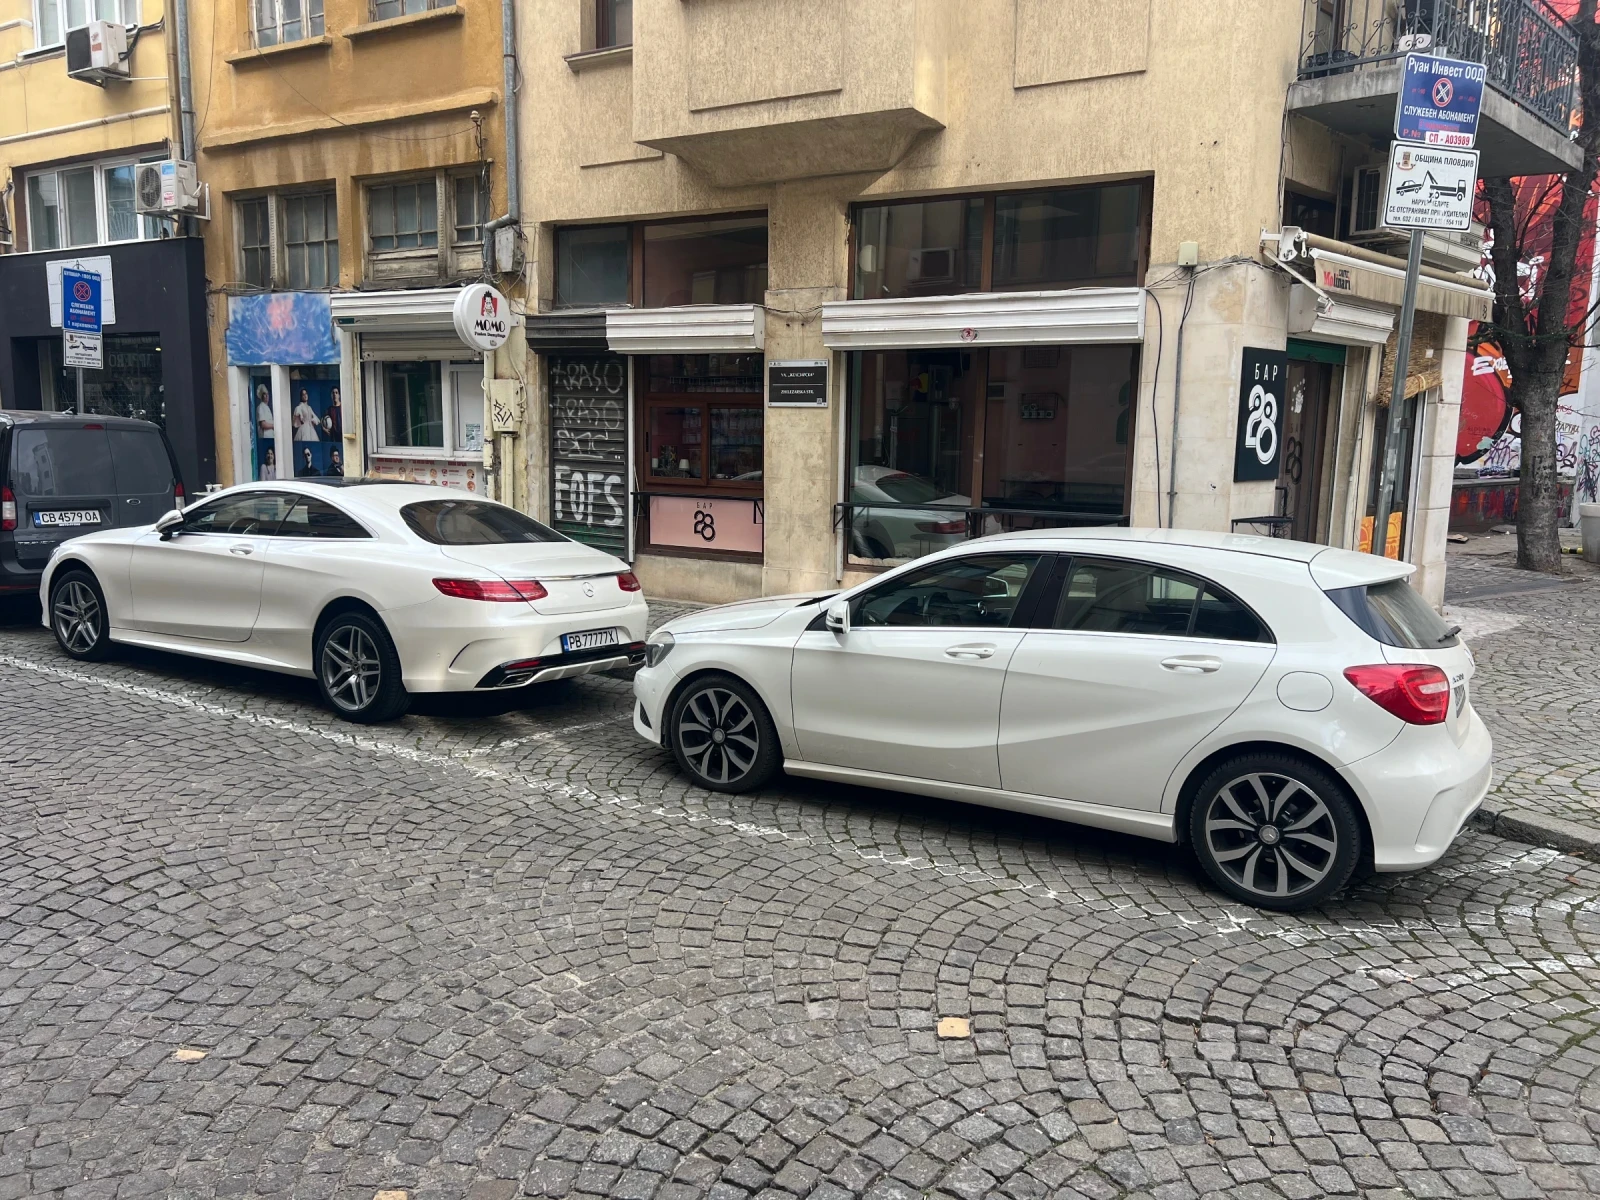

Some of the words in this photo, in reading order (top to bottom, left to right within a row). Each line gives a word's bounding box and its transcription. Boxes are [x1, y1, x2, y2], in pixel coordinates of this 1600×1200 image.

[1408, 57, 1430, 75] Руан
[1431, 61, 1463, 78] Инвест
[1464, 66, 1484, 83] ООД
[1403, 105, 1437, 119] СЛУЖЕБЕН
[1437, 110, 1475, 123] АБОНАМЕНТ
[1414, 153, 1443, 165] ОБЩИНА
[1443, 157, 1474, 168] ПЛОВДИВ
[474, 319, 506, 333] MOMO
[1254, 363, 1278, 381] БАР
[1245, 384, 1278, 465] 28
[554, 465, 623, 528] FOFS
[694, 510, 716, 542] 28
